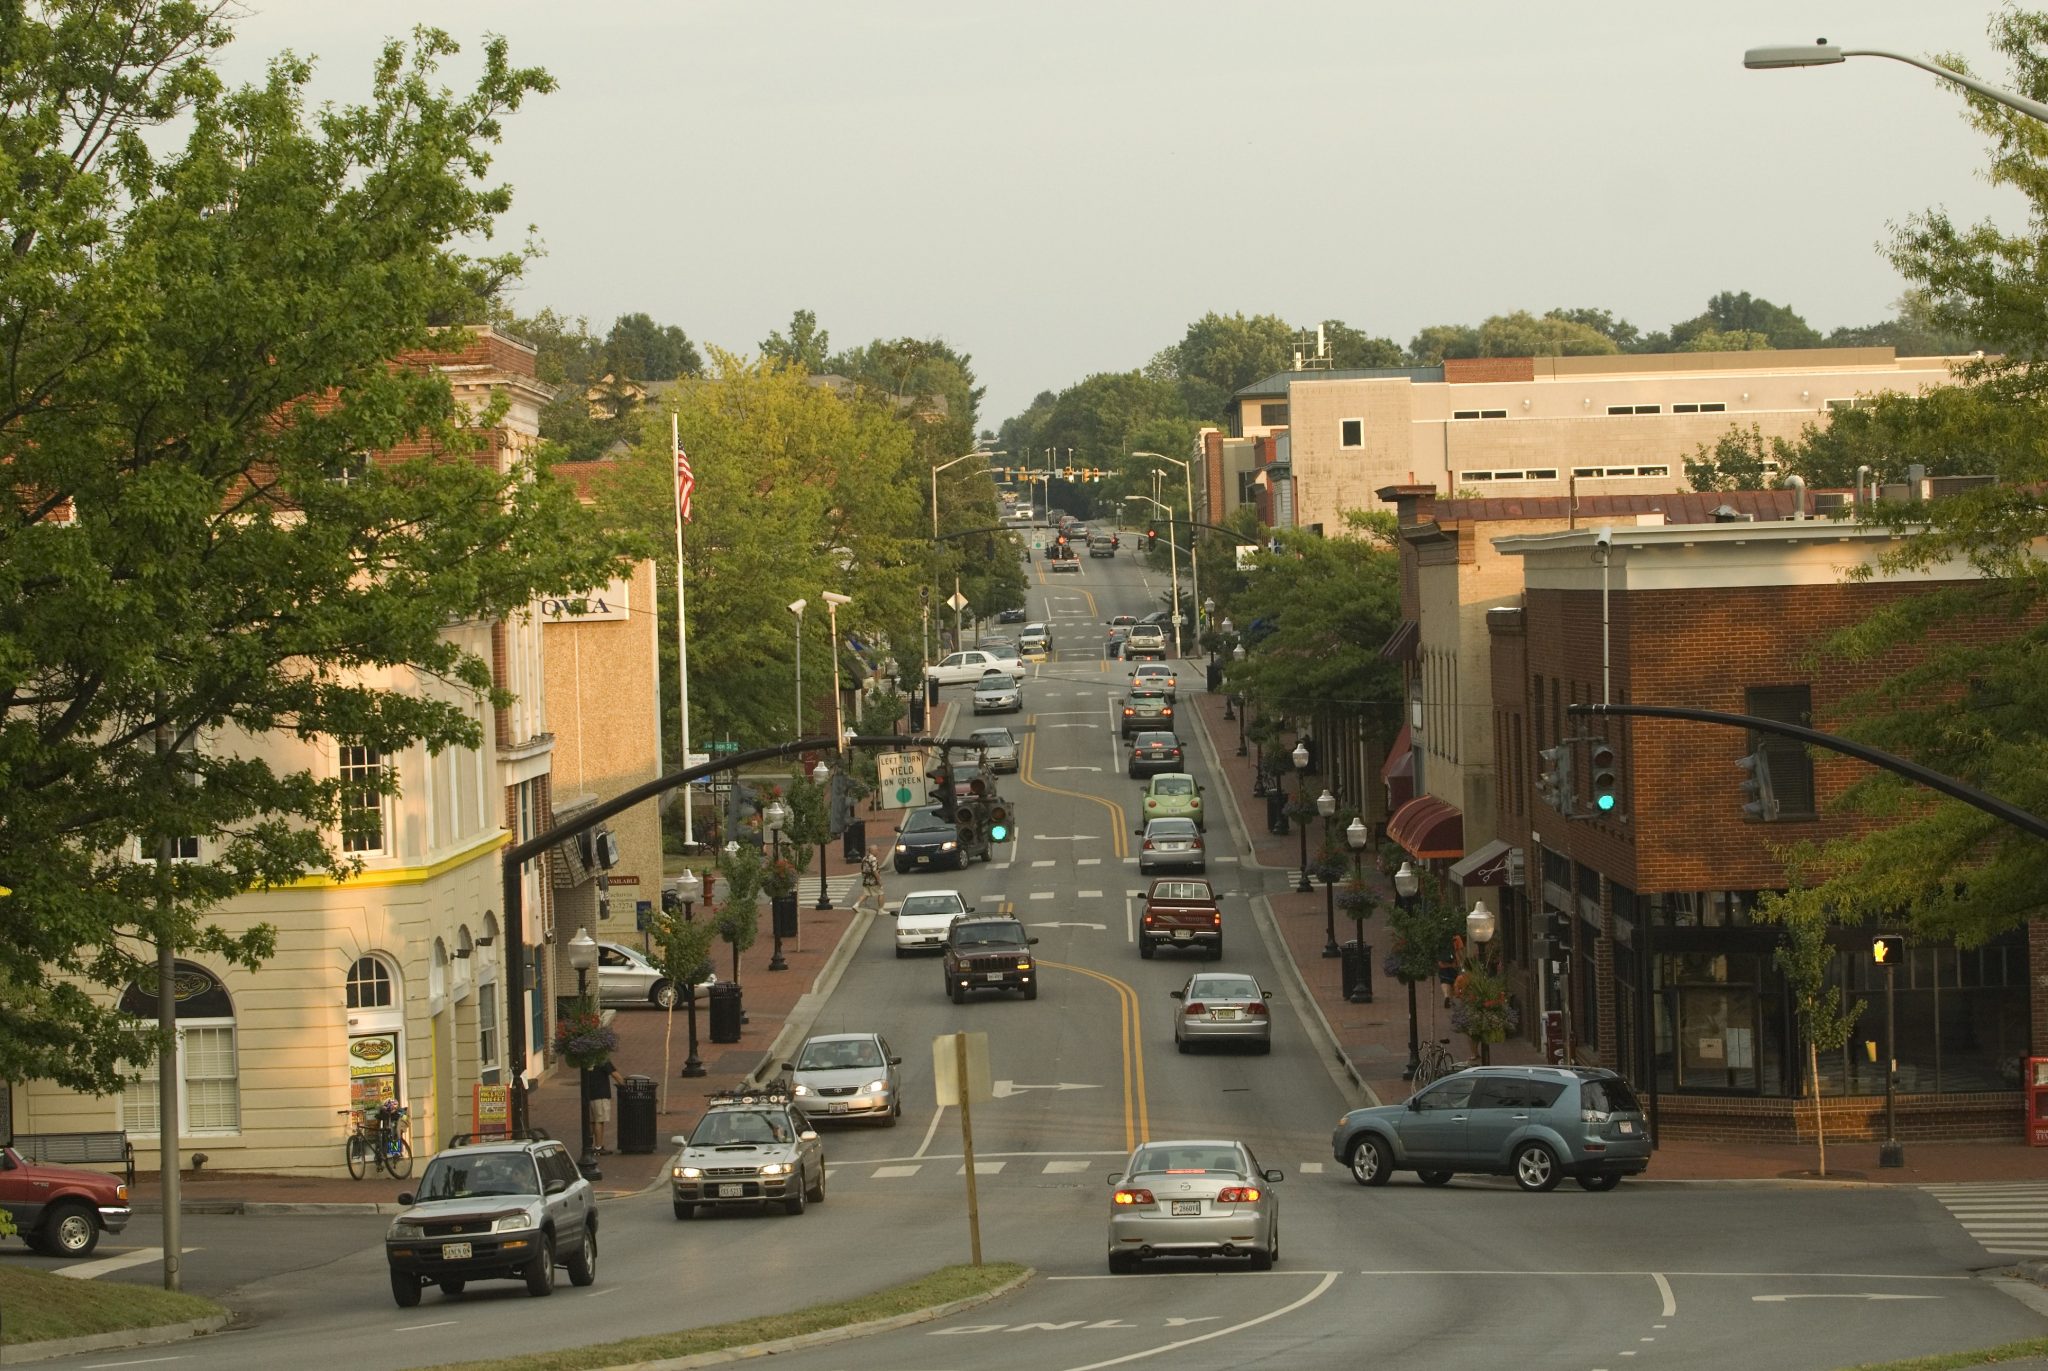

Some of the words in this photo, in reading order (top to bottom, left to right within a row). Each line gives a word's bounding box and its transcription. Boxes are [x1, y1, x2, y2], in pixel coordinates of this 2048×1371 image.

[542, 598, 612, 615] OVA
[881, 757, 897, 765] LEFT
[903, 755, 921, 763] TURN
[890, 765, 914, 776] YIELD
[898, 776, 921, 785] GREEN
[926, 1316, 1224, 1335] ONLY
